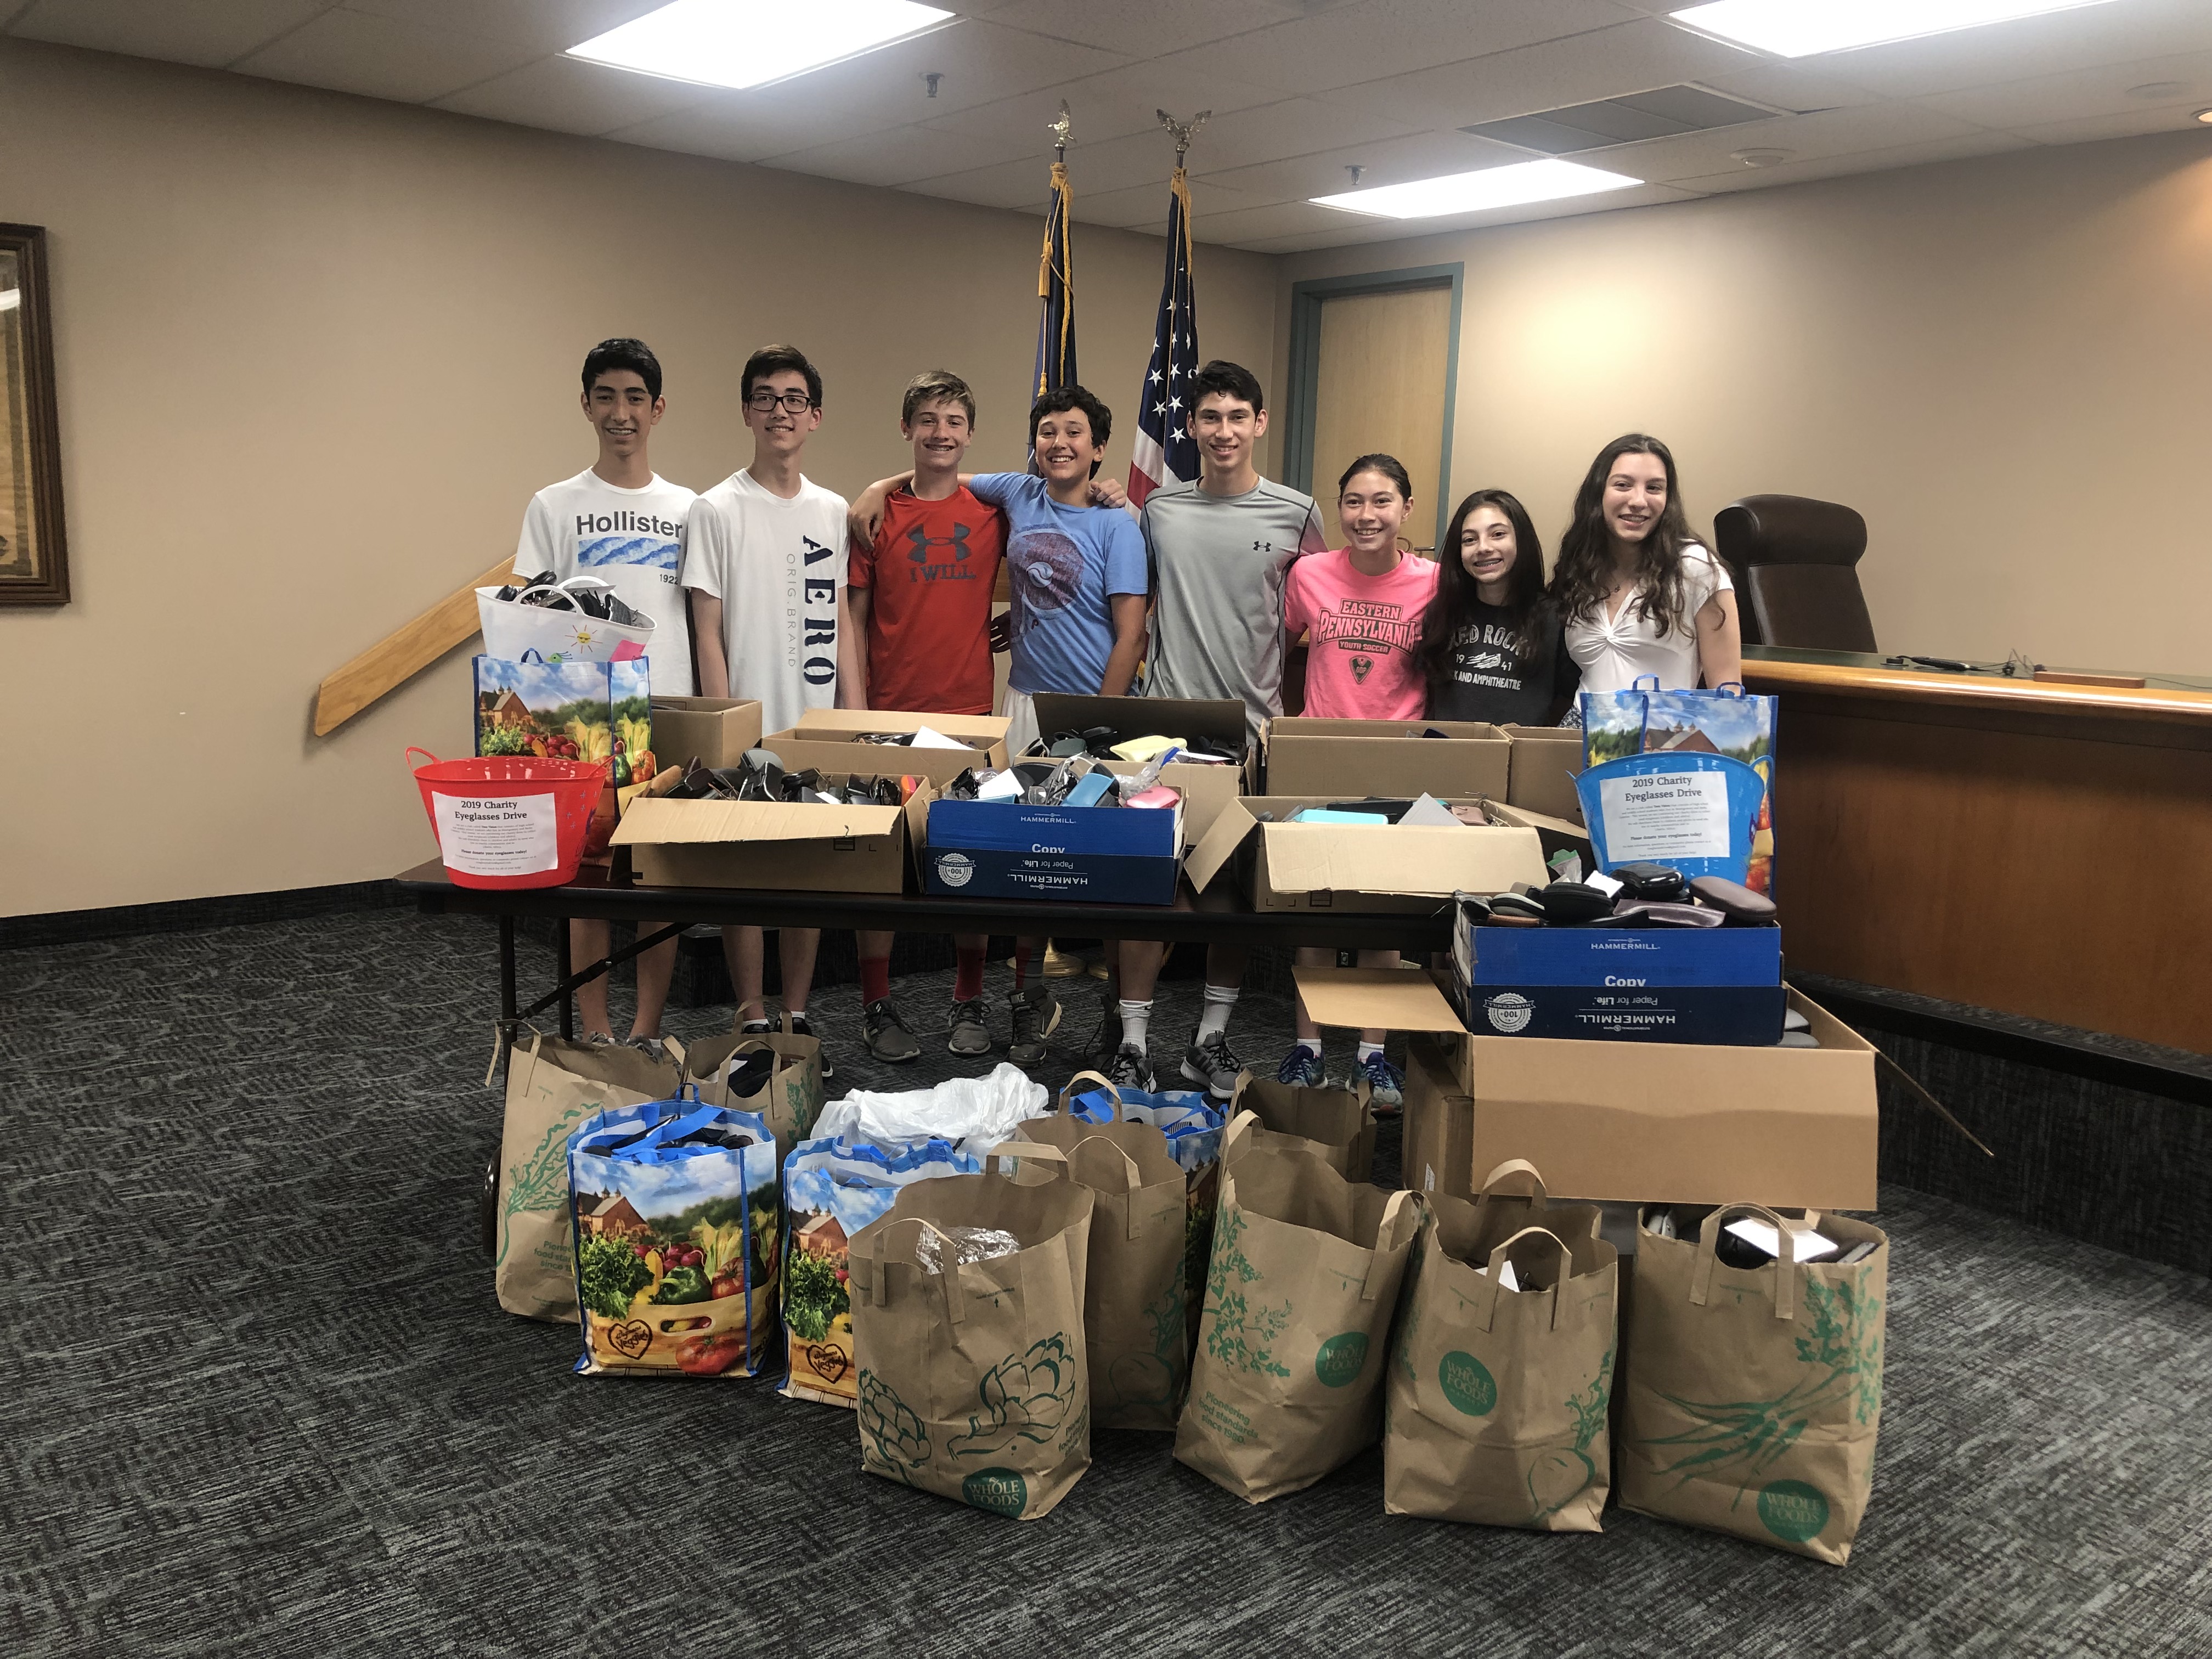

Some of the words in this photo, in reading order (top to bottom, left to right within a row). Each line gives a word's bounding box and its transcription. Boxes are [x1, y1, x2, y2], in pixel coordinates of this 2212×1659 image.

[577, 511, 682, 538] Hollister
[659, 574, 679, 585] 1922
[910, 567, 917, 582] I
[803, 535, 836, 685] AERO
[1341, 601, 1400, 619] EASTERN
[1318, 611, 1417, 653] PENNSYLVANIA
[1340, 641, 1362, 650] YOUTH
[1363, 644, 1389, 653] SOCCER
[1456, 653, 1465, 664] 19
[1500, 661, 1512, 672] 41
[1458, 671, 1472, 683] AND
[1472, 674, 1522, 691] AMPHITHEATRE
[1632, 778, 1654, 788] 2019
[1657, 776, 1692, 786] Charity
[1625, 791, 1674, 803] Eyeglasses
[1677, 788, 1702, 797] Drive
[461, 800, 481, 809] 2019
[484, 801, 517, 810] Charity
[455, 811, 500, 822] Eyeglasses
[504, 811, 527, 820] Drive
[1011, 874, 1087, 884] HAMMERMILL
[1632, 996, 1657, 1005] Paper
[1578, 1015, 1675, 1024] HAMMERMILL
[534, 1248, 553, 1259] food
[540, 1260, 563, 1270] since
[616, 1329, 648, 1349] Veggies
[1447, 1361, 1491, 1394] WHOLE
[1447, 1373, 1488, 1404] FOODS
[1206, 1391, 1250, 1425] Pioneering
[1198, 1397, 1215, 1415] food
[1216, 1412, 1259, 1438] standards
[1202, 1415, 1222, 1432] since
[967, 1478, 1019, 1494] WHOLE
[972, 1493, 1019, 1505] FOODS
[1769, 1506, 1820, 1524] FOODS
